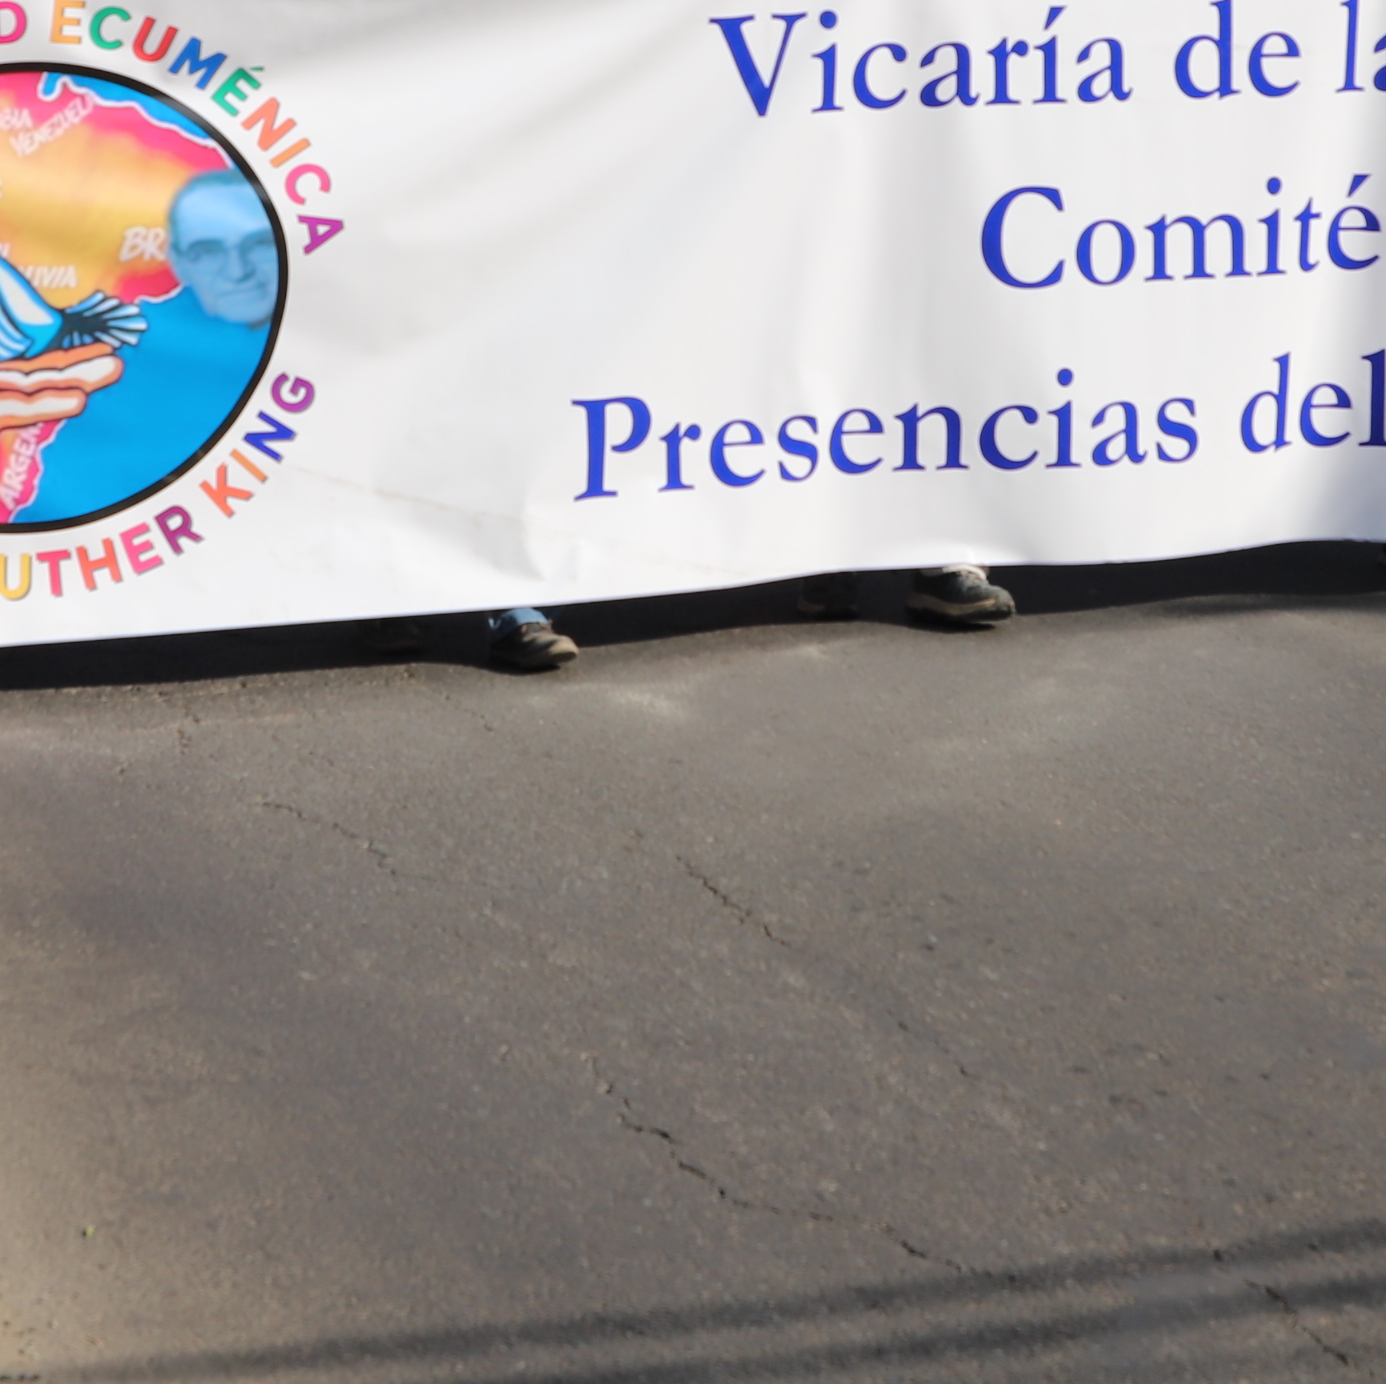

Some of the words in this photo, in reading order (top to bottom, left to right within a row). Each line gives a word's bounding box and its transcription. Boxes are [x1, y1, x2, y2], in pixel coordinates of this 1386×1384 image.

[711, 7, 1131, 116] Vicaría
[9, 94, 95, 157] VENEZUEL
[981, 174, 1381, 289] Comité
[200, 372, 315, 518] KING
[572, 369, 1198, 501] Presencias
